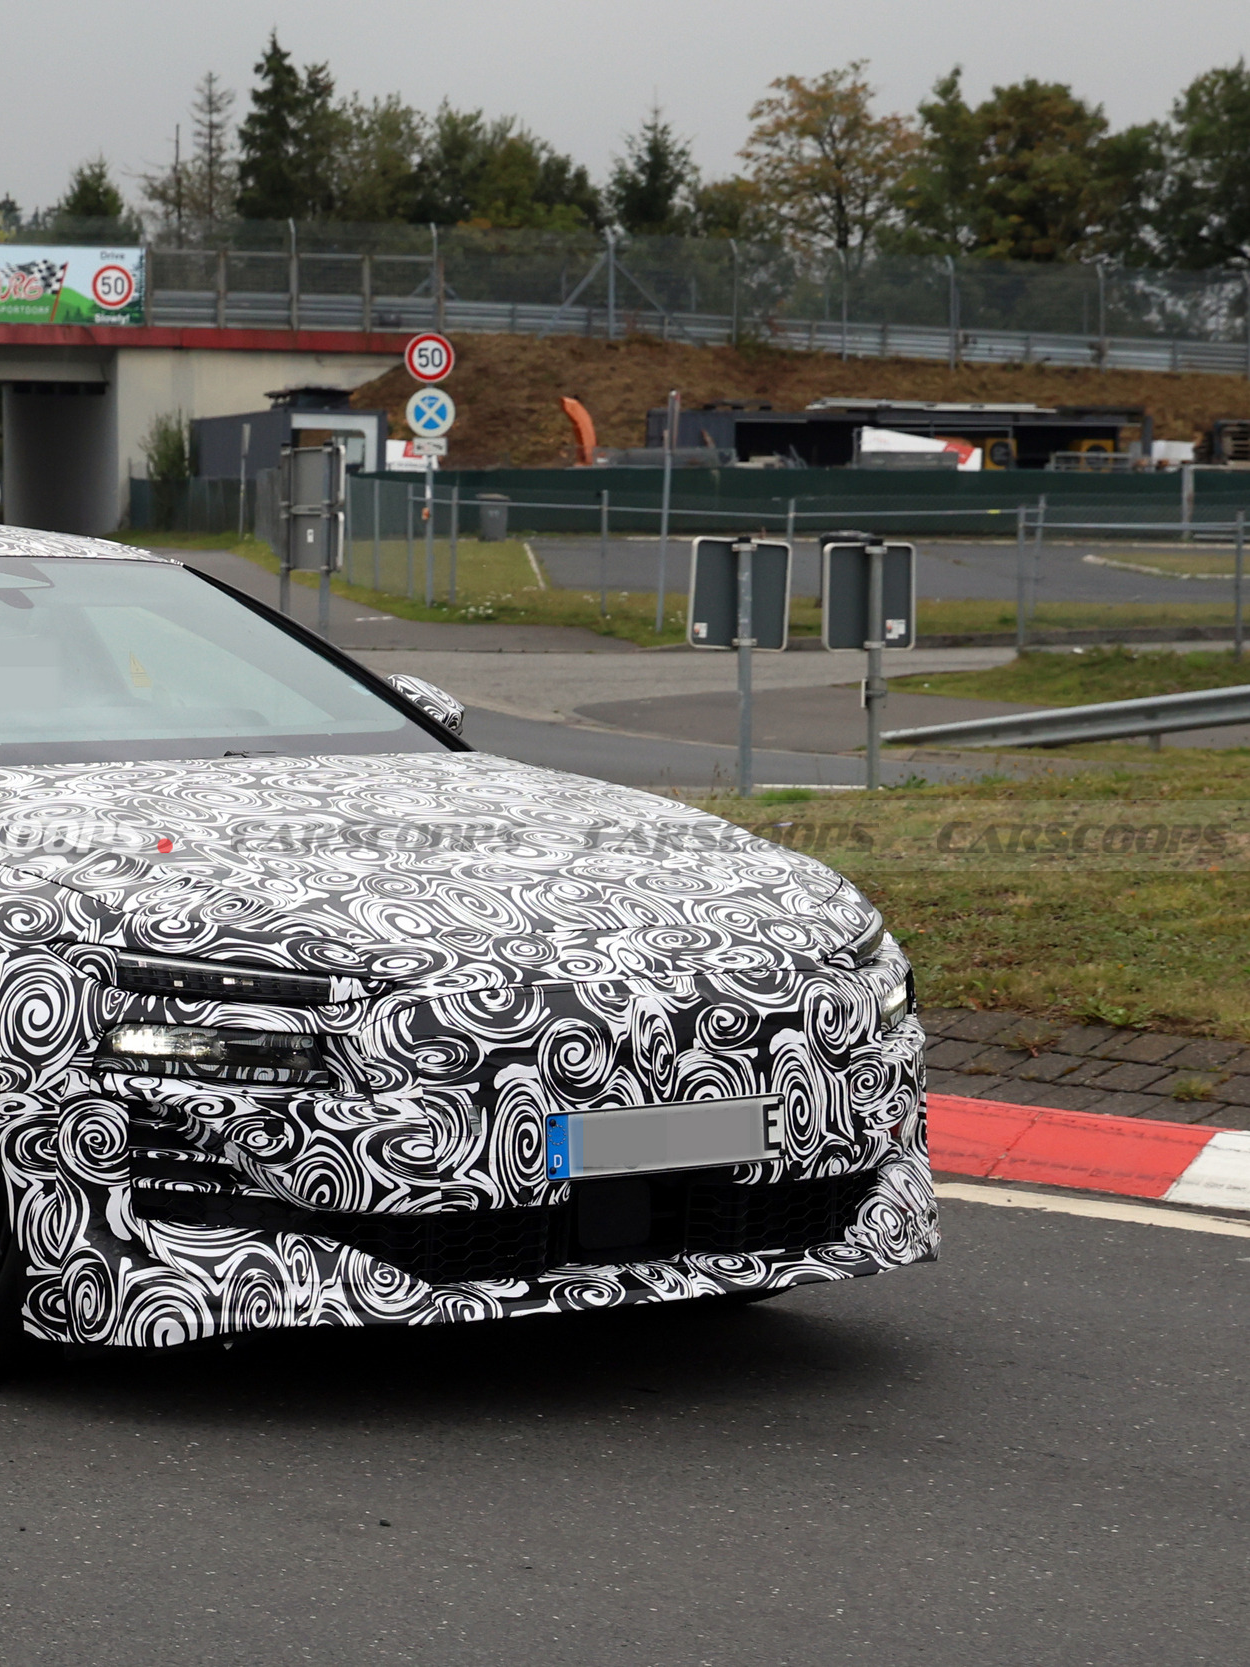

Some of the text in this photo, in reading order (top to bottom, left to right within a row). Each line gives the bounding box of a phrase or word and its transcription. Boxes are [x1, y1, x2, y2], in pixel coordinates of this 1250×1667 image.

[100, 251, 125, 260] Drive
[101, 276, 125, 296] 50
[418, 348, 443, 368] 50
[553, 1154, 563, 1169] D
